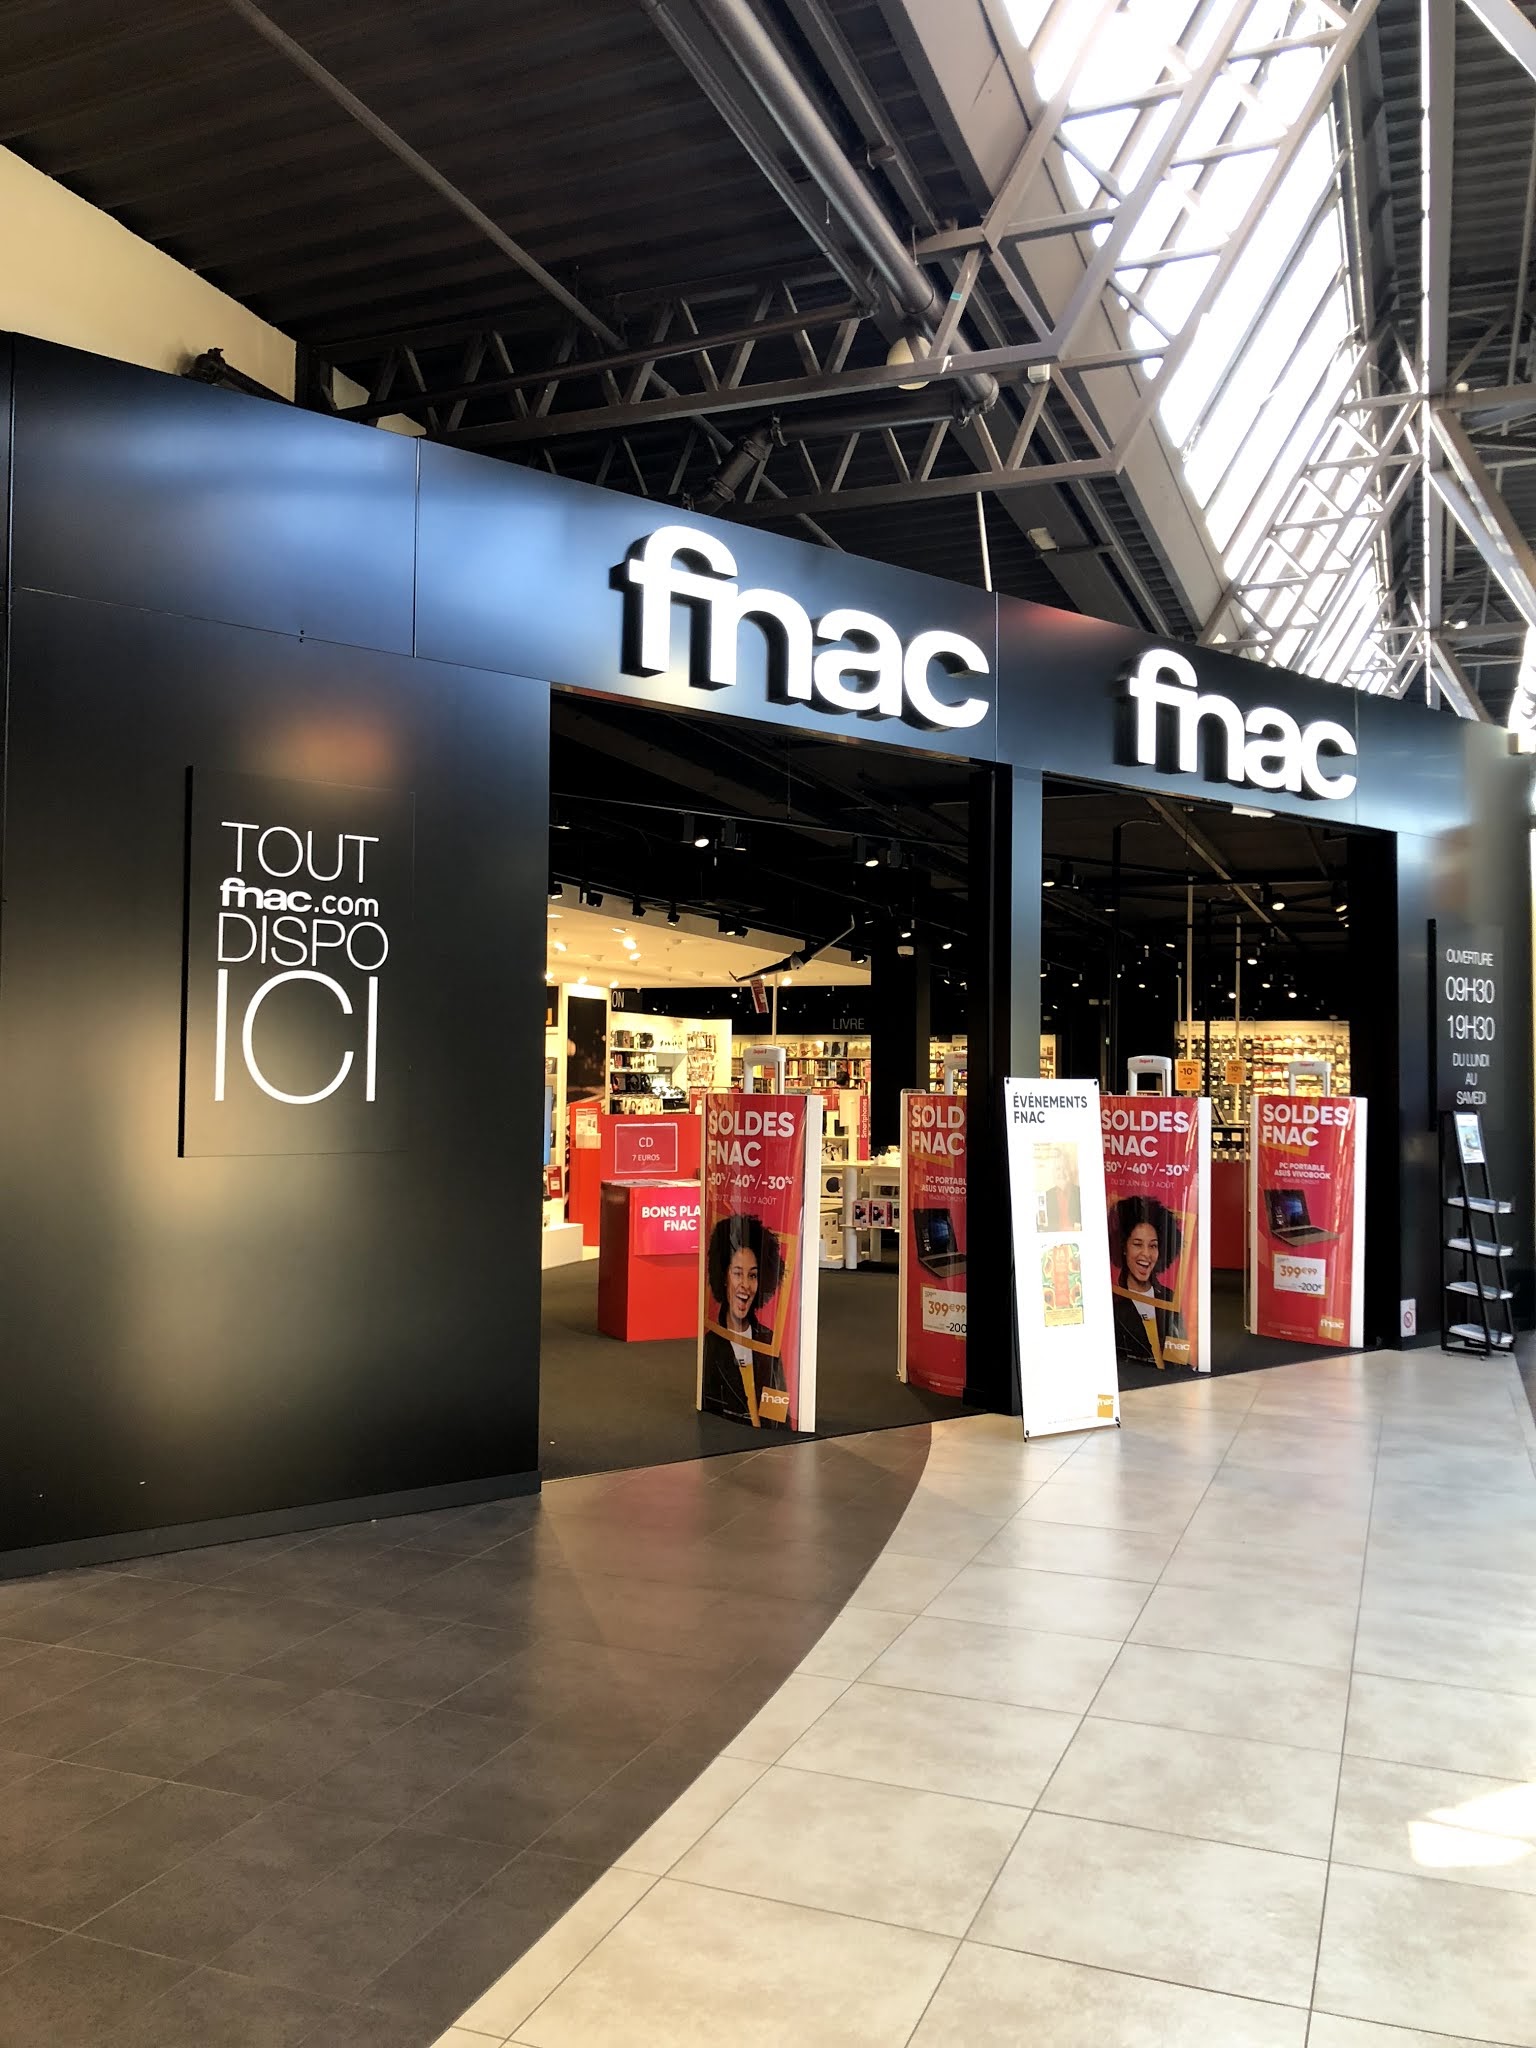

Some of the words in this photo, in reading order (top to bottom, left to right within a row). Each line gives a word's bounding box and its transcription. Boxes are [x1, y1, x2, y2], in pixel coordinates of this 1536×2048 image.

[628, 525, 990, 729] fnac
[1129, 648, 1358, 800] fnac
[221, 821, 380, 884] TOUT
[219, 877, 379, 918] fnac.com
[217, 912, 389, 971] DISPO
[1446, 949, 1494, 967] OUVERTURE
[1445, 975, 1495, 1004] 09H30
[832, 1018, 865, 1030] LIVRE
[1447, 1014, 1496, 1041] 19H30
[214, 968, 378, 1105] ICI
[1452, 1053, 1466, 1067] DU
[1467, 1053, 1490, 1067] LUNDI
[1465, 1072, 1478, 1086] AU
[1013, 1092, 1088, 1108] ÉVÉNEMENTS
[1456, 1091, 1487, 1105] SAMEDI
[708, 1110, 795, 1138] SOLDES
[860, 1098, 869, 1139] Smartphones
[911, 1105, 965, 1129] SOLD
[1013, 1111, 1045, 1124] FNAC
[1101, 1109, 1190, 1133] SOLDES
[1262, 1103, 1350, 1127] SOLDES
[638, 1137, 654, 1148] CD
[911, 1131, 966, 1156] FNAC
[1103, 1134, 1159, 1158] FNAC
[1262, 1125, 1320, 1147] FNAC
[632, 1154, 637, 1162] 7
[638, 1153, 661, 1161] EUROS
[707, 1140, 762, 1167] FNAC
[1273, 1169, 1291, 1177] ASUS
[1292, 1171, 1331, 1179] VIVOBOOK
[1290, 1163, 1325, 1172] PORTABLE
[926, 1175, 934, 1183] PC
[641, 1206, 677, 1218] BONS
[679, 1205, 701, 1217] PLA
[663, 1219, 697, 1232] FNAC
[1164, 1340, 1191, 1351] fnac
[761, 1392, 790, 1405] fnac
